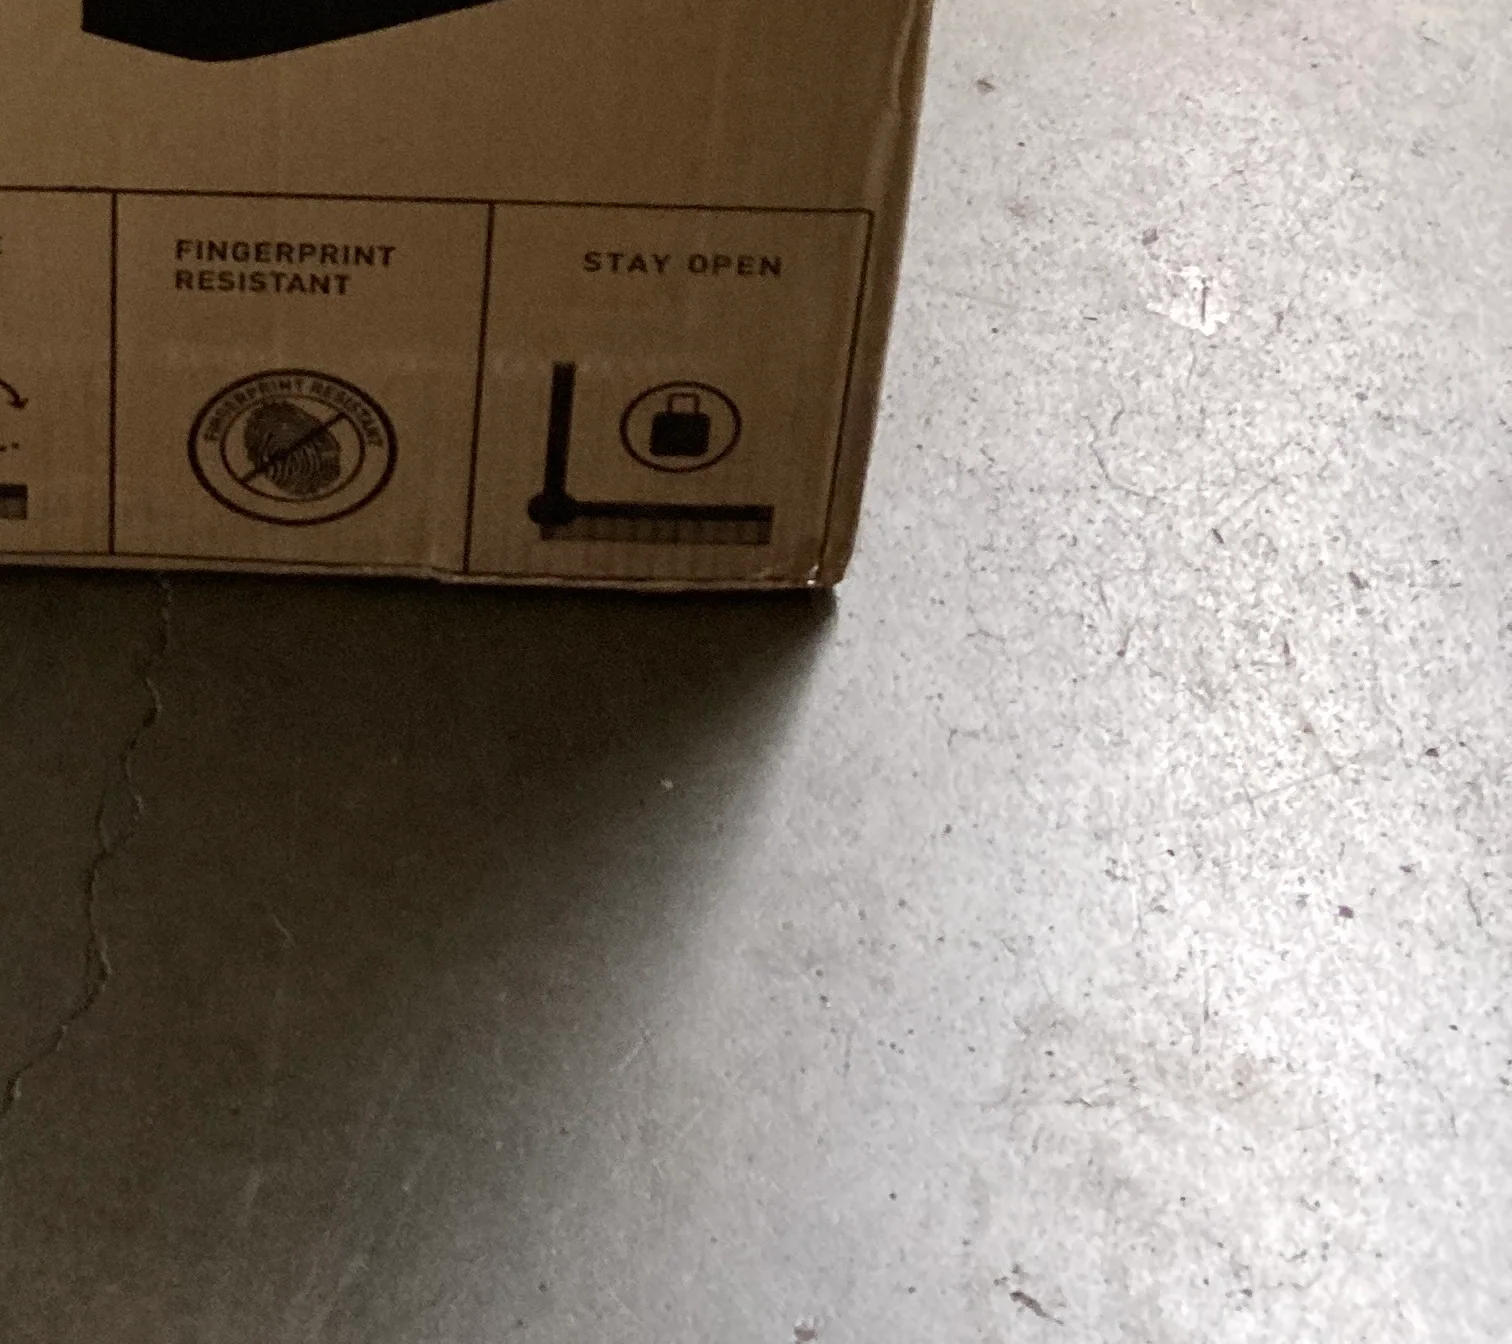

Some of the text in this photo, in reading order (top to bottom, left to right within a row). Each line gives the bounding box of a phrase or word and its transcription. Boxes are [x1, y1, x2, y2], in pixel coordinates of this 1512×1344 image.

[174, 238, 397, 269] FINGERPRINT
[583, 250, 784, 278] STAY OPEN
[174, 269, 352, 297] RESISTANT
